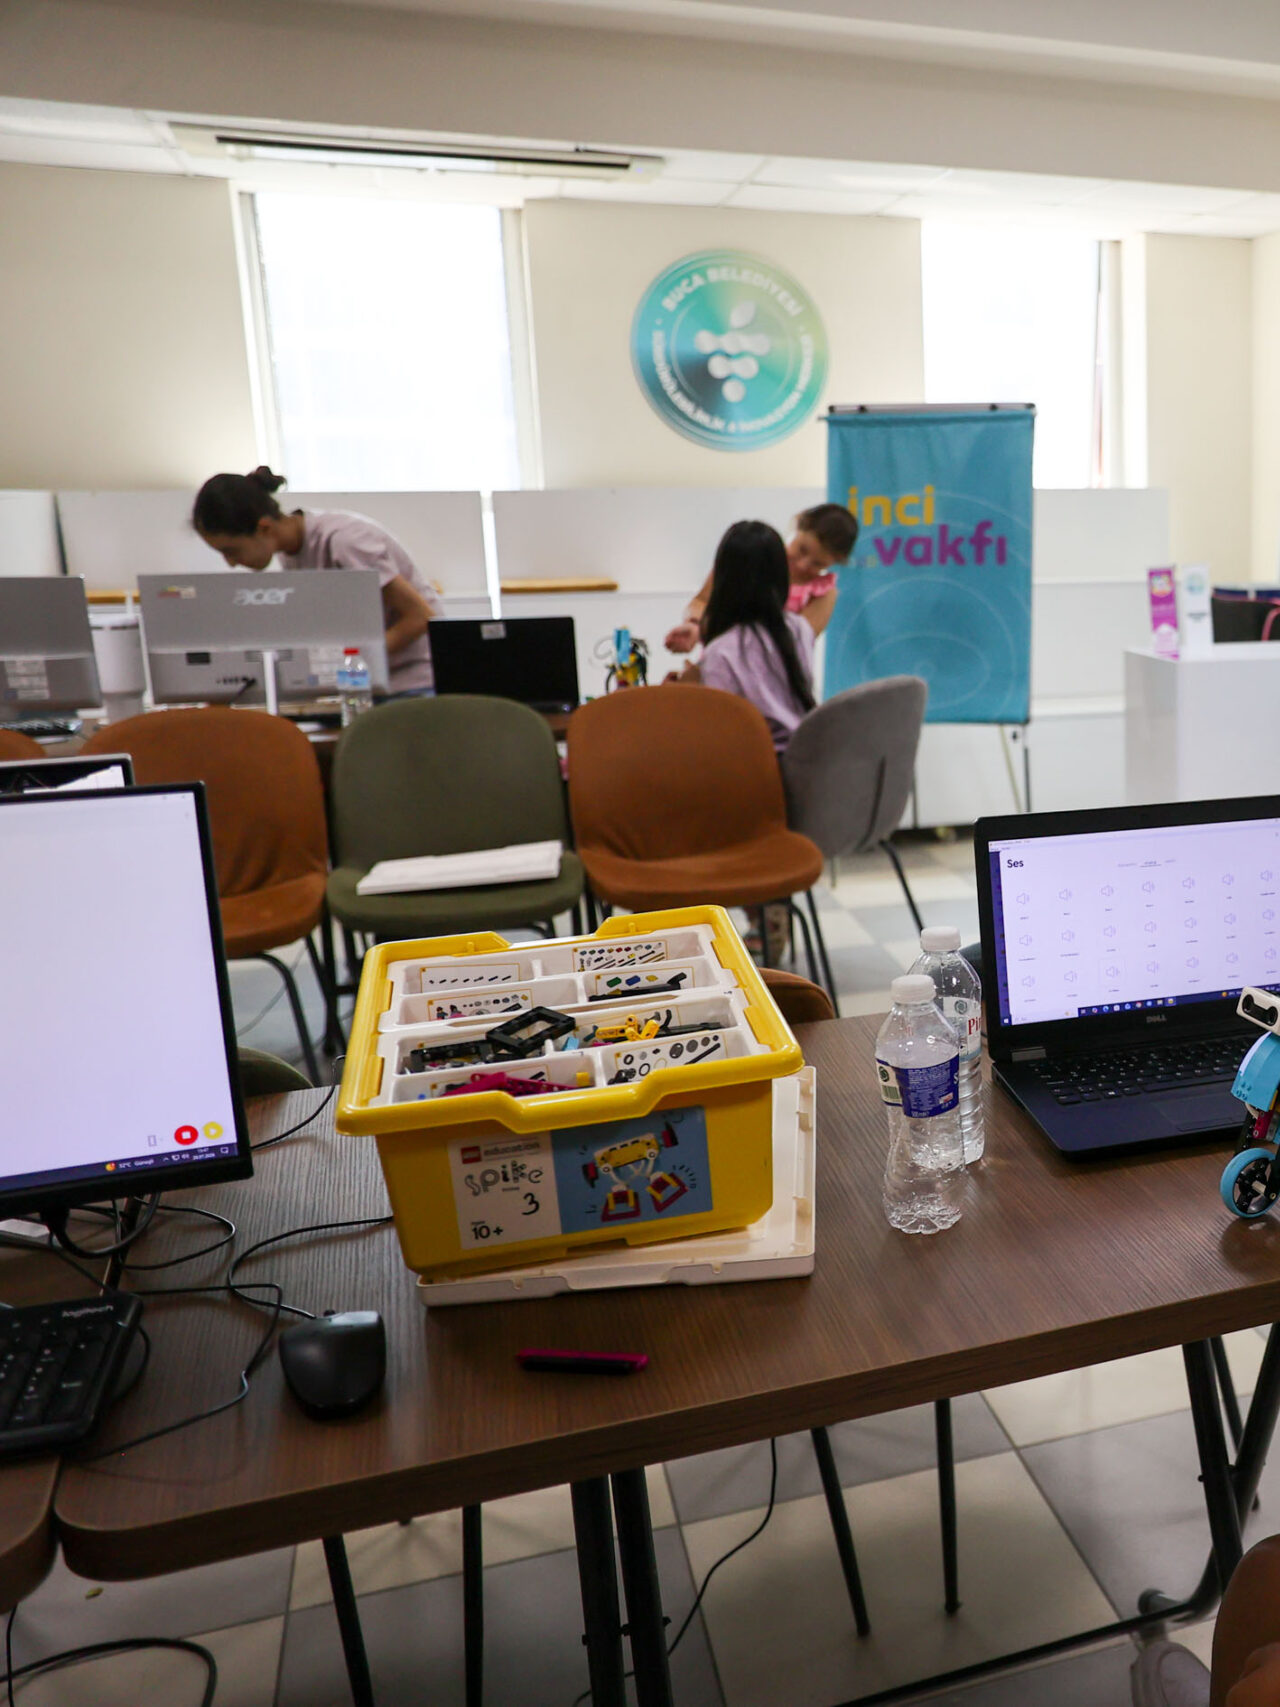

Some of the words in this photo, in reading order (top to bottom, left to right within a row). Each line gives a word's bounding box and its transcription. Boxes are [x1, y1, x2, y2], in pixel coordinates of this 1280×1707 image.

[661, 272, 706, 312] BUCA
[846, 484, 936, 526] inci
[872, 519, 1008, 567] vakfı
[232, 587, 296, 606] acer
[1006, 858, 1025, 869] Ses
[521, 1192, 541, 1216] 3
[471, 1224, 504, 1241] 10+
